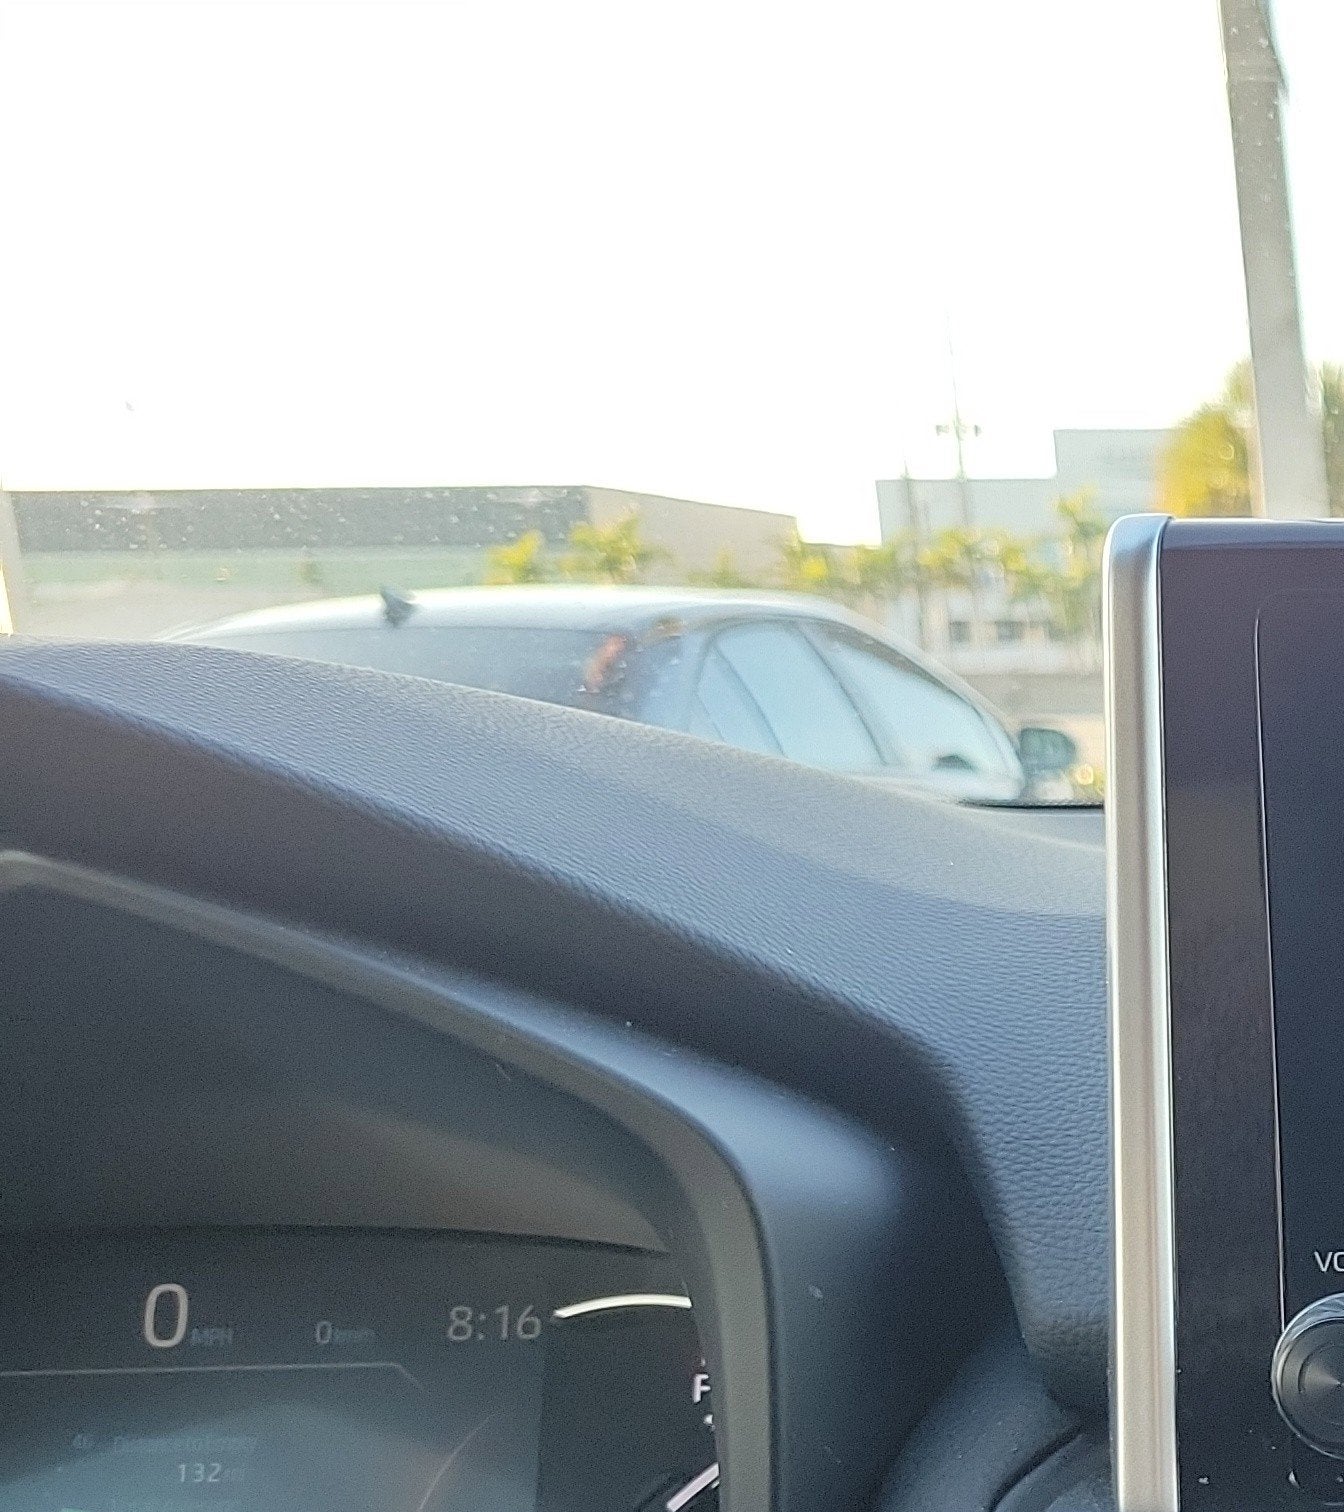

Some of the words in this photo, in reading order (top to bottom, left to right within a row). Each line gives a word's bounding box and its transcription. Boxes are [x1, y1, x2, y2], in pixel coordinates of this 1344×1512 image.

[143, 1283, 189, 1348] 0
[447, 1303, 541, 1342] 8:16
[693, 1373, 711, 1403] F
[177, 1462, 222, 1484] 132
